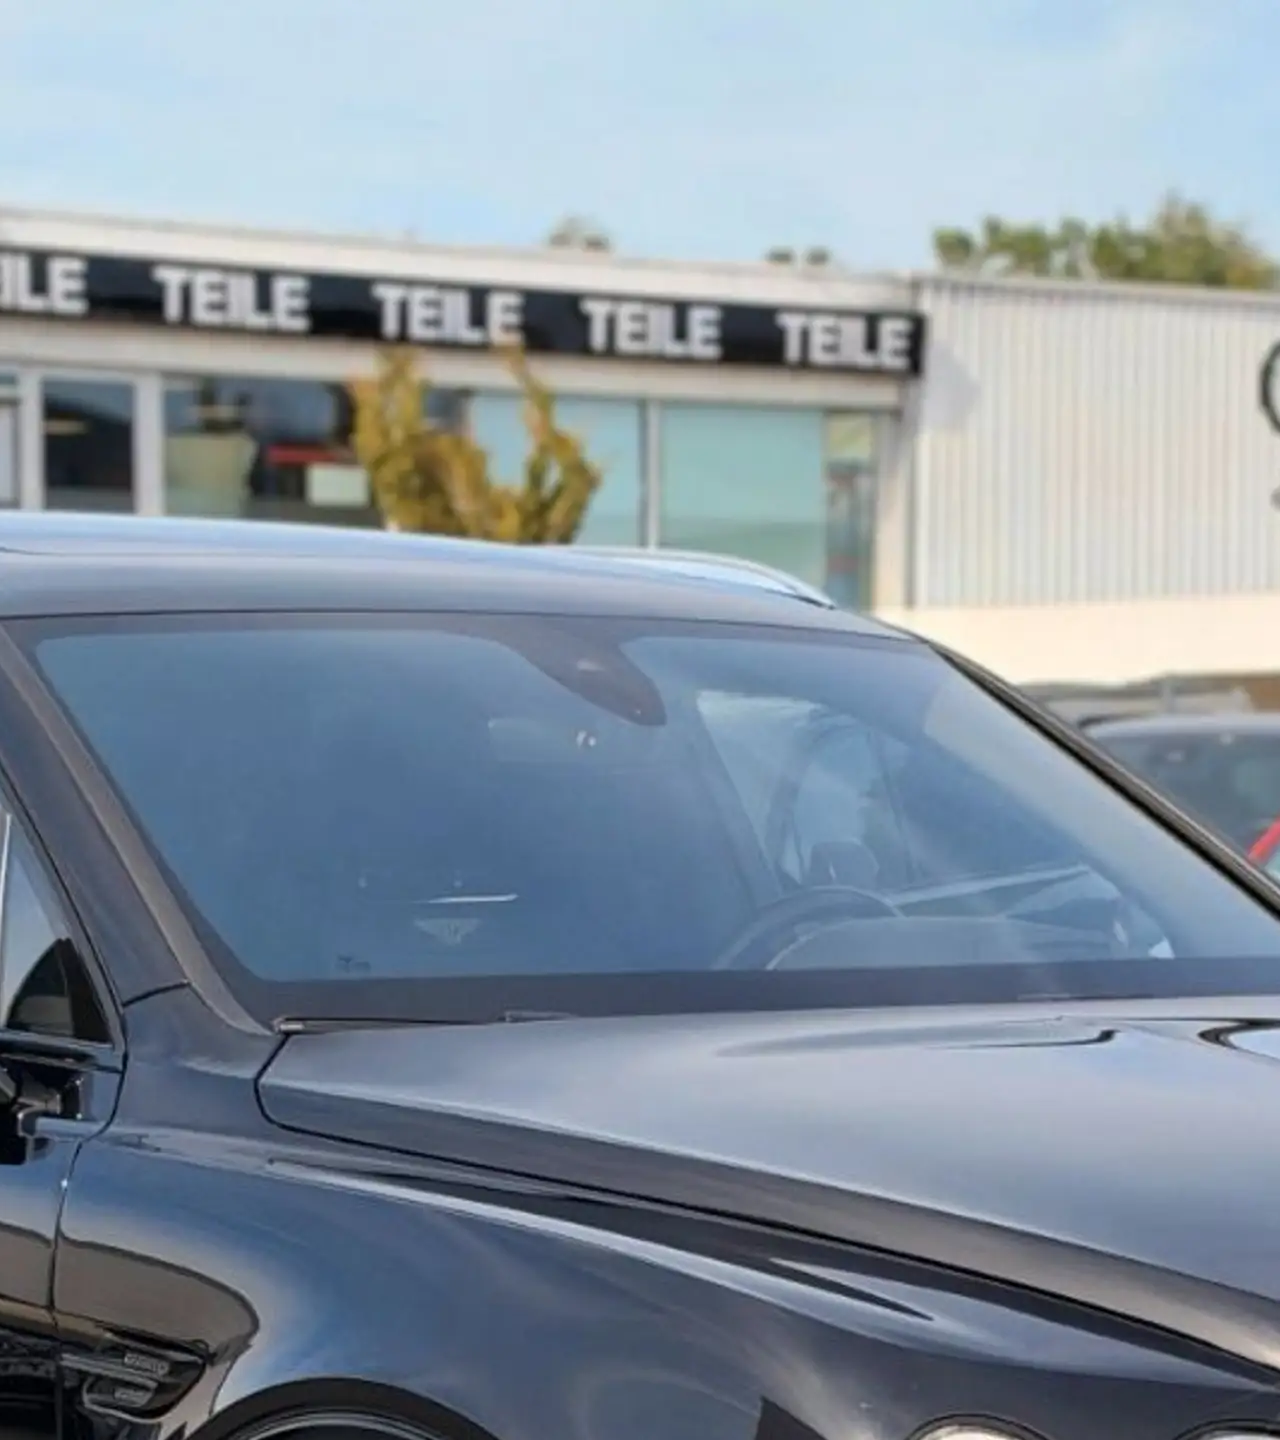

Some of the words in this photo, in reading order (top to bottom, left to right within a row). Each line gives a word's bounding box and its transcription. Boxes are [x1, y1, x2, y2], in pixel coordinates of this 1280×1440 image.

[153, 266, 311, 331] TEILE
[371, 283, 524, 344] TEILE
[579, 299, 722, 359] TEILE
[776, 312, 913, 371] TEILE
